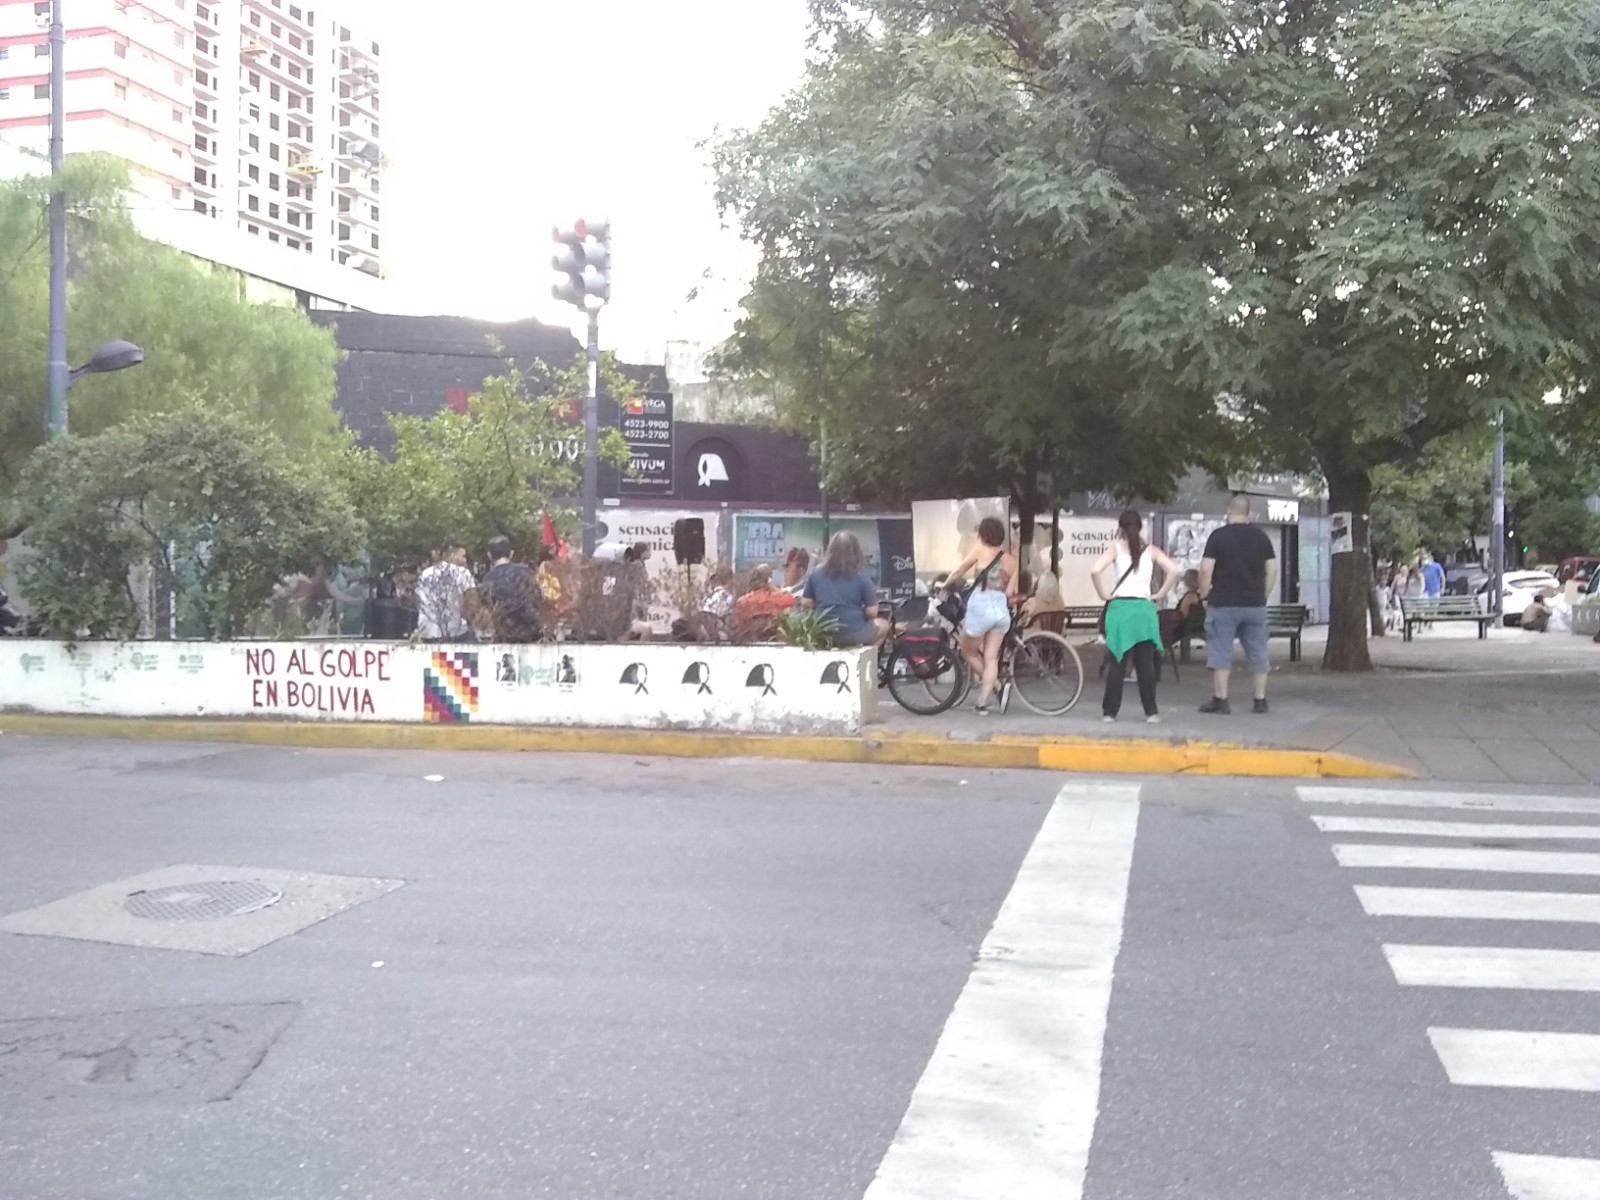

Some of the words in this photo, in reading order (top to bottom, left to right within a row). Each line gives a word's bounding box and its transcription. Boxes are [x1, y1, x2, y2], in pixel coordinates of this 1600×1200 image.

[624, 419, 670, 429] 4523-9900
[624, 430, 670, 440] 4523-2700
[618, 522, 676, 536] sensaci
[1071, 543, 1109, 555] térmi
[246, 648, 275, 676] NO
[286, 648, 315, 676] AL
[320, 649, 391, 681] GOLPE
[253, 679, 279, 707] EN
[286, 680, 375, 714] BOLIVIA
